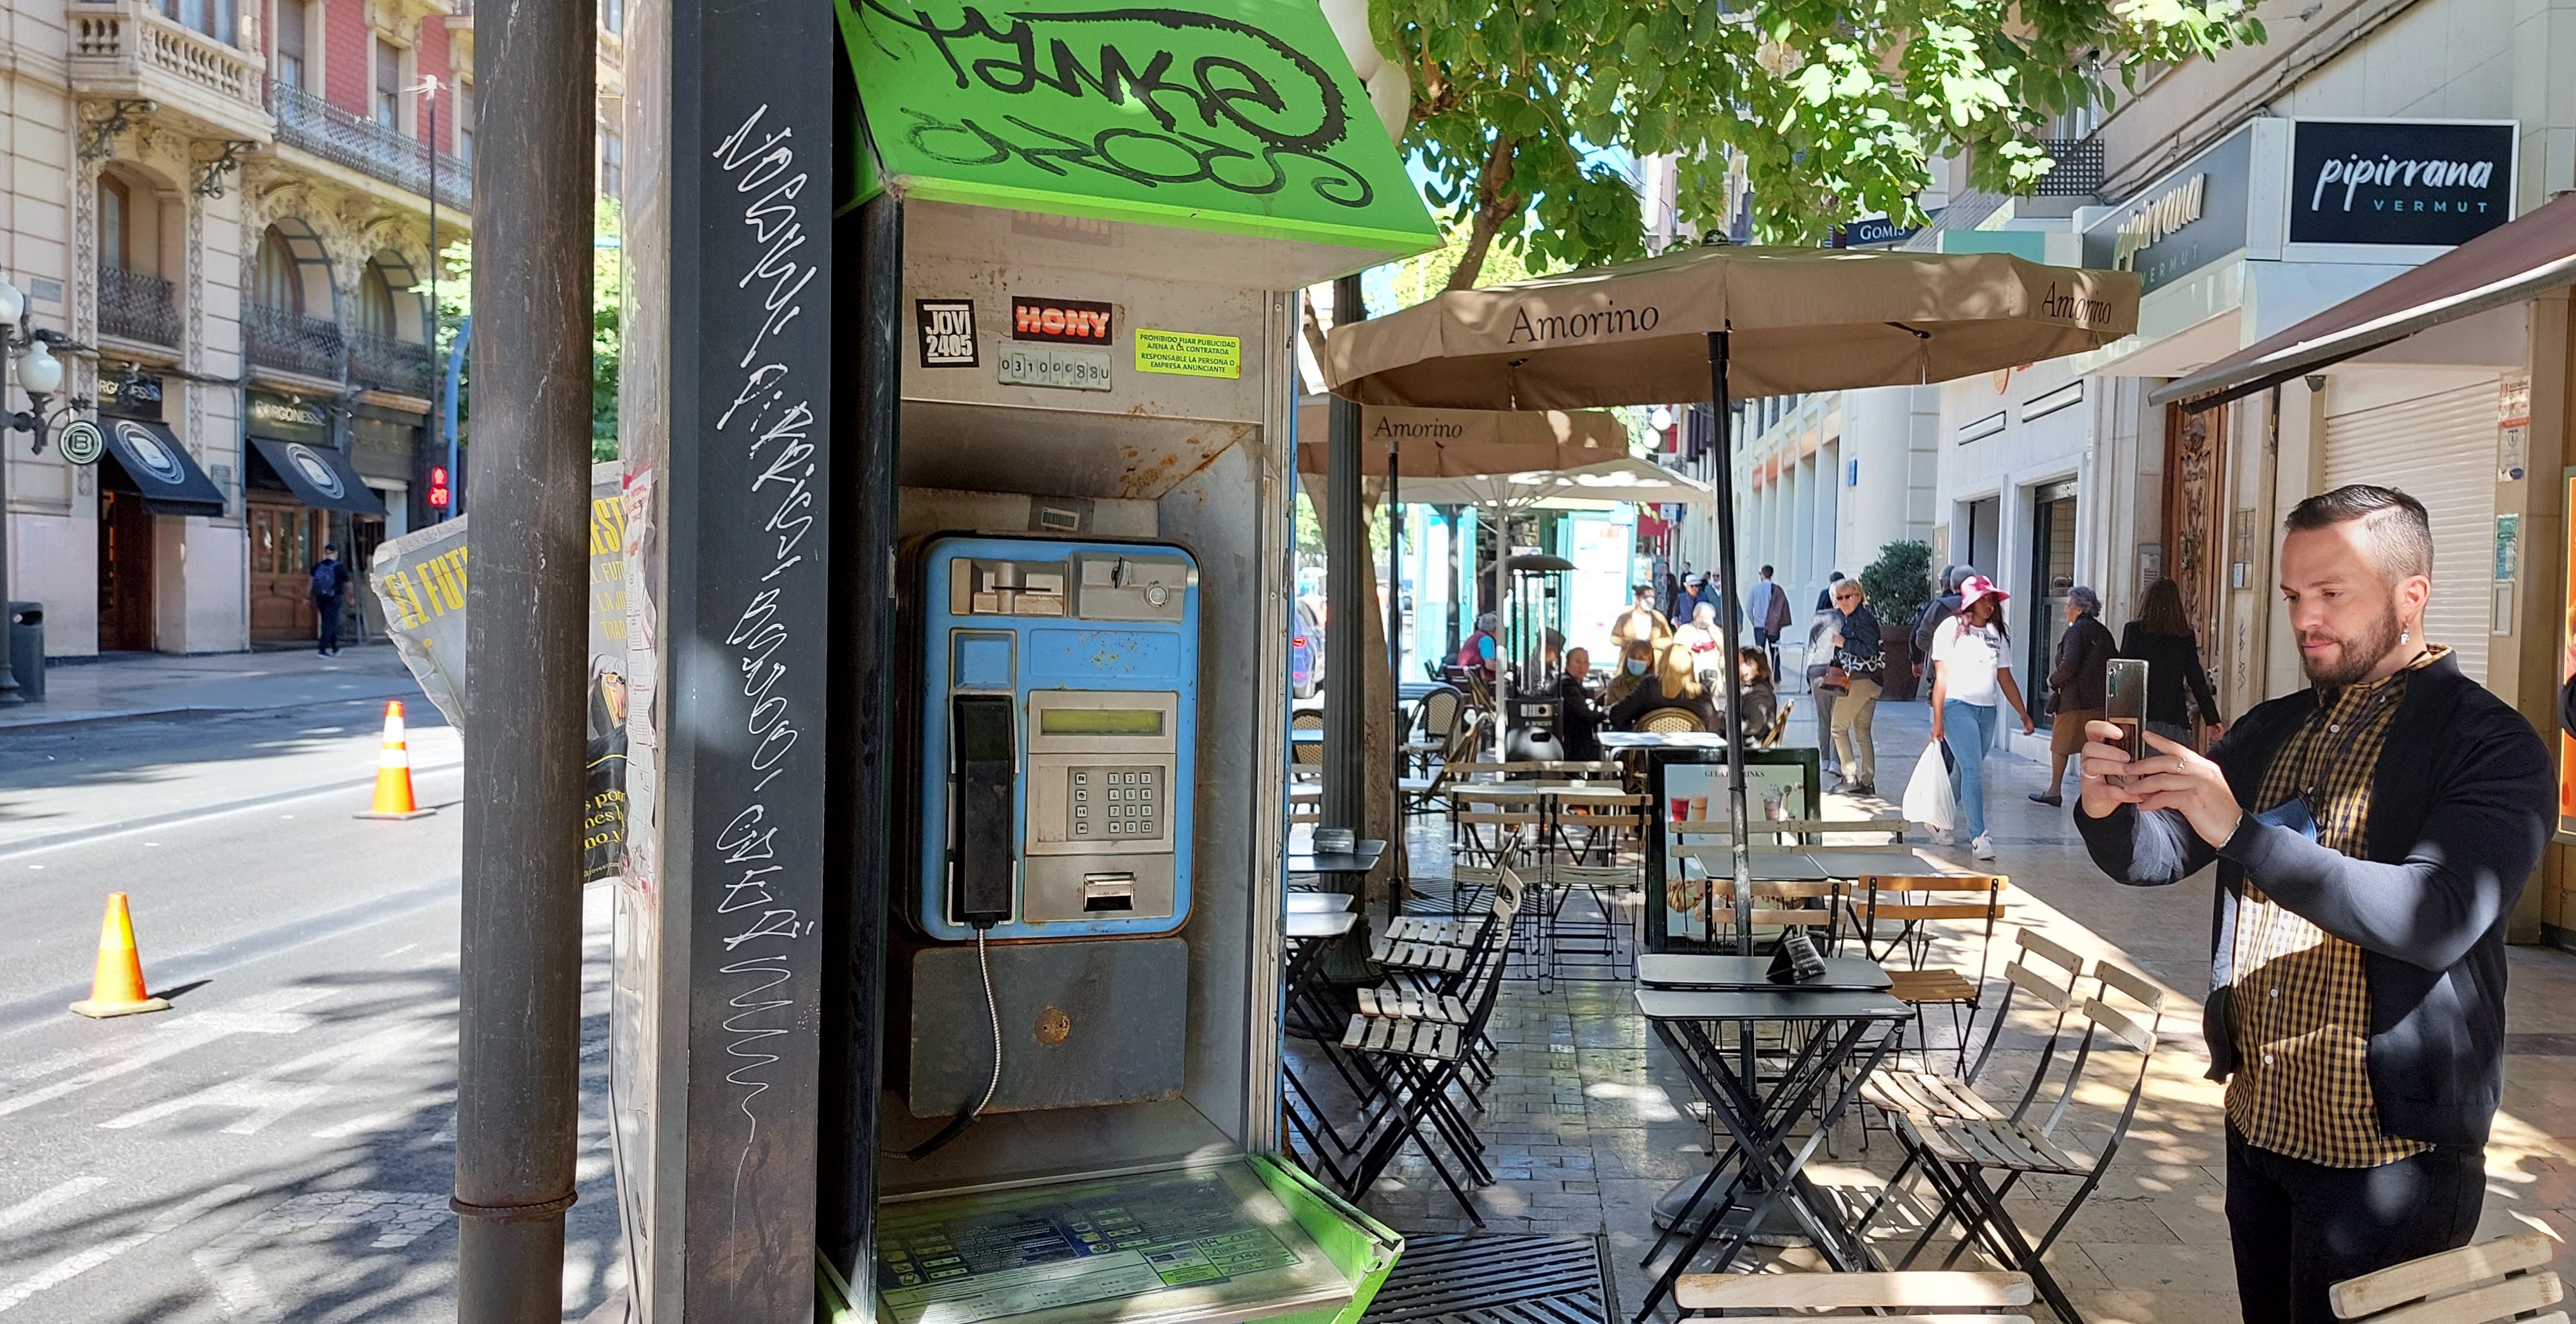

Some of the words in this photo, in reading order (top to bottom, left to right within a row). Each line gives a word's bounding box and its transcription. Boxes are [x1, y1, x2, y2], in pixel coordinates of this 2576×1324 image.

[2311, 153, 2494, 212] pipirrana
[2373, 199, 2488, 213] VERMUT
[2041, 281, 2112, 324] Amorino
[925, 311, 972, 335] JOVI
[1016, 306, 1110, 338] HONY
[1506, 300, 1659, 344] Amorino
[926, 335, 973, 357] 2405
[1140, 334, 1178, 343] PROHIBIDO
[1197, 339, 1236, 348] PUBLICIDAD
[1186, 346, 1229, 355] CONTRATADA
[1141, 353, 1187, 362] RESPONSABLE
[1198, 357, 1228, 365] PERSONA
[1150, 361, 1182, 370] EMPRESA
[1182, 364, 1226, 373] ANUNCIANTE
[1373, 416, 1463, 438] Amorino
